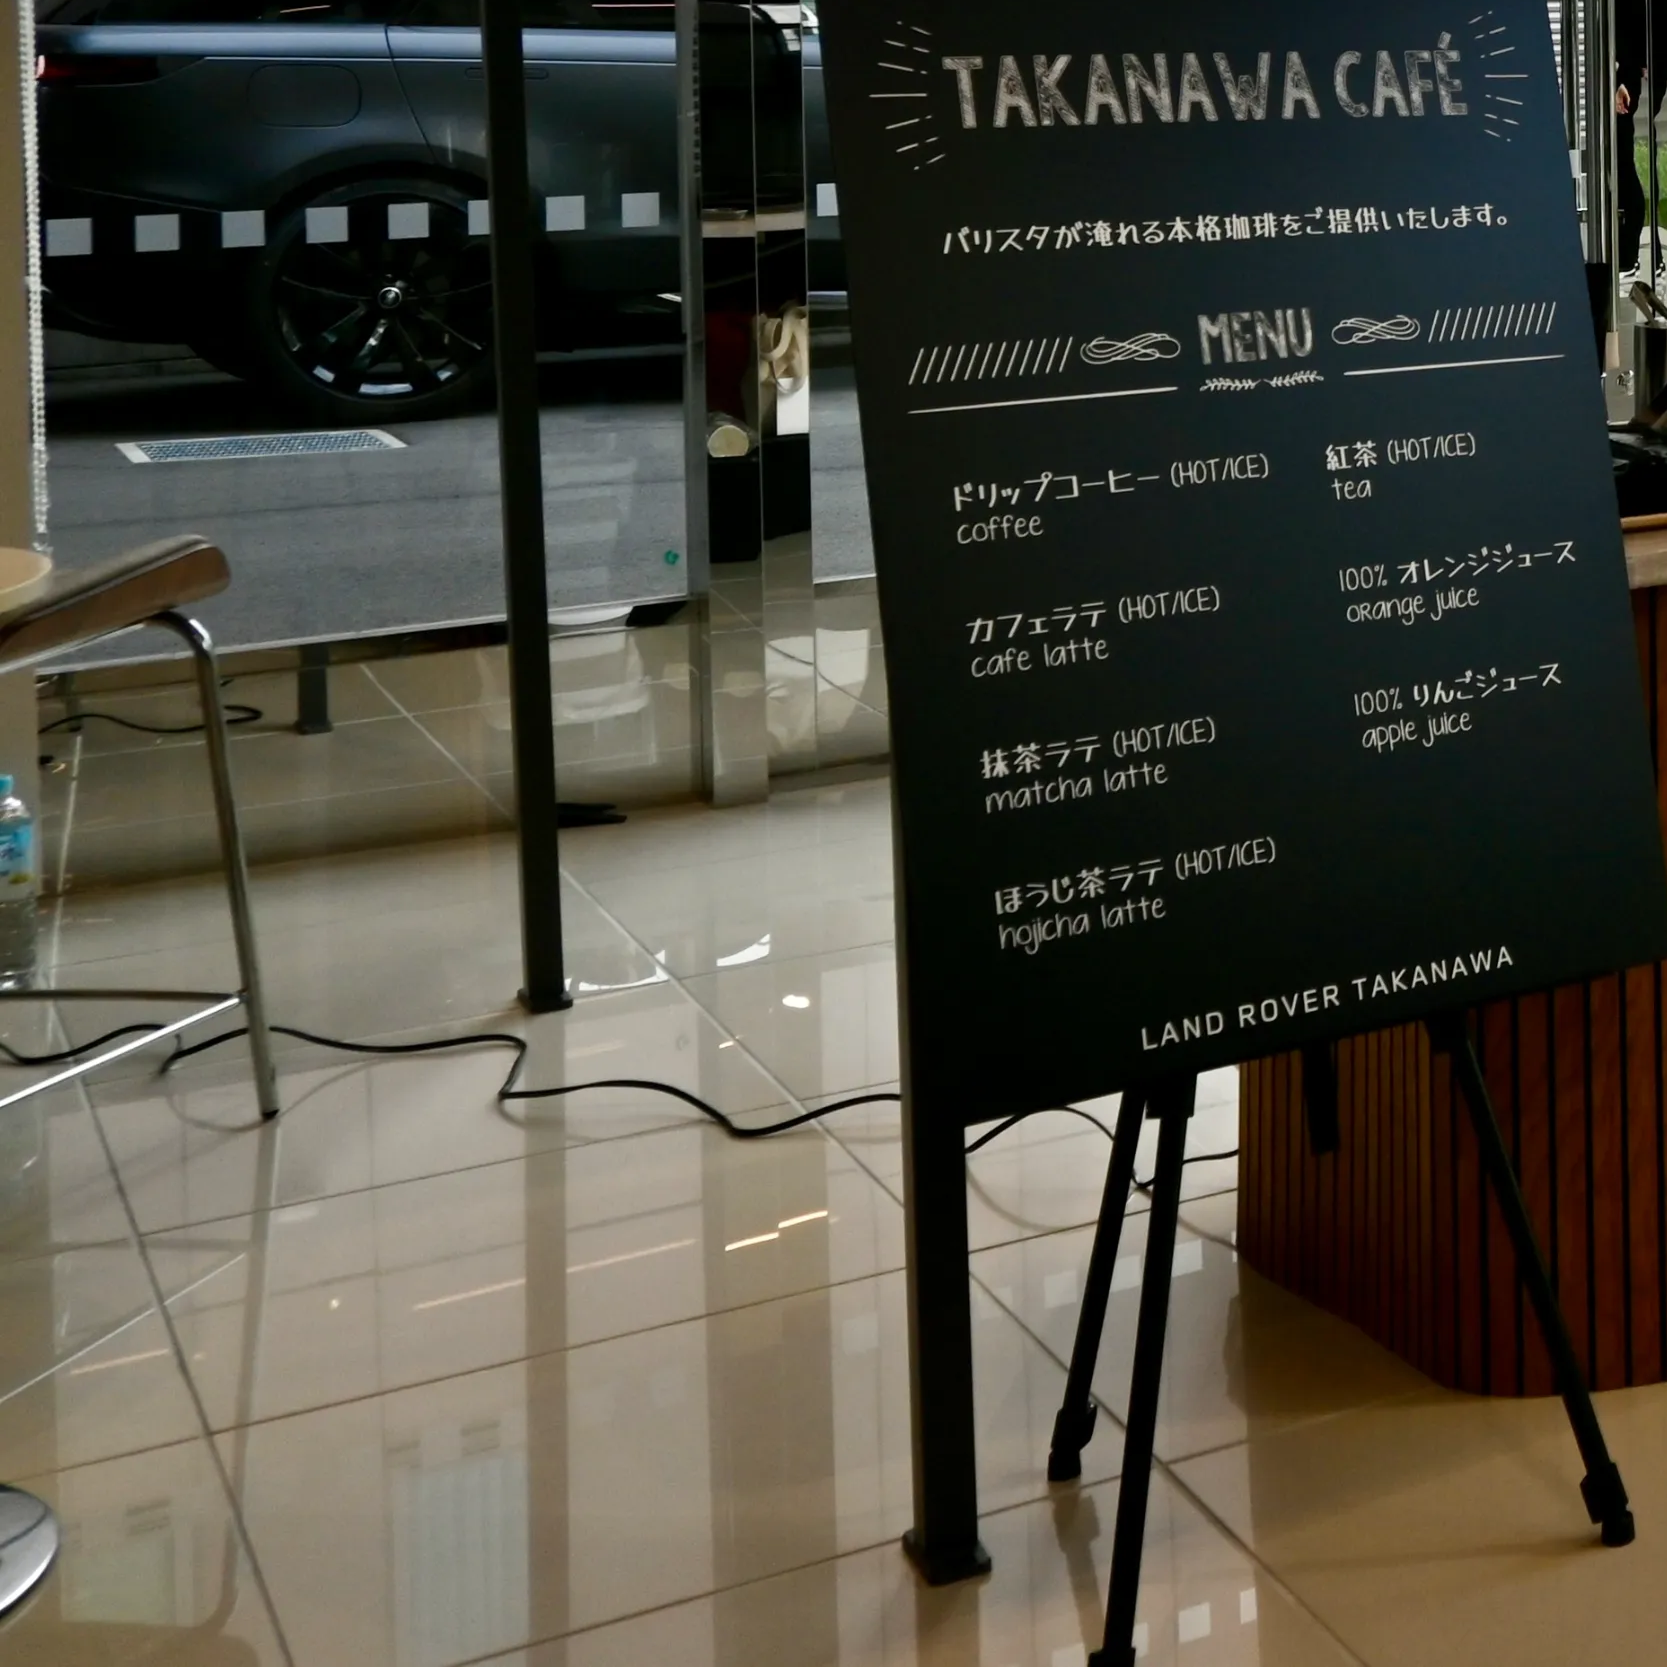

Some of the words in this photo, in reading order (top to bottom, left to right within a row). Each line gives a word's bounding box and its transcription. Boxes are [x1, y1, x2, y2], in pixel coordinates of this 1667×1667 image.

[943, 51, 1320, 128] TAKANAWA
[1334, 31, 1468, 117] CAFÉ
[1198, 307, 1313, 365] MENU
[1326, 440, 1377, 471] 紅茶
[1387, 432, 1475, 464] (HOT/ICE)
[954, 470, 1159, 511] ドリップコーヒー
[1171, 453, 1268, 487] (HOT/ICE)
[1332, 478, 1371, 500] tea
[958, 515, 1043, 544] coffee
[1339, 564, 1387, 591] 100%
[1397, 541, 1575, 583] オレンジジュース
[967, 602, 1106, 644] カフェラテ
[1119, 586, 1219, 623] (HOT/ICE)
[1431, 587, 1479, 621] juice
[972, 648, 1031, 677] cafe
[1044, 638, 1108, 666] latte
[1355, 688, 1402, 715] 100%
[1414, 663, 1561, 707] りんごジュース
[980, 736, 1100, 778] 抹茶ラテ
[1113, 717, 1215, 757] (HOT/ICE)
[1362, 719, 1417, 753] apple
[1423, 712, 1472, 747] juice
[986, 777, 1092, 813] matcha
[1104, 762, 1167, 792] latte
[995, 859, 1165, 915] ほうじ茶ラテ
[1176, 837, 1275, 880] (HOT/ICE)
[999, 914, 1088, 954] hojicha
[1101, 898, 1165, 928] latte
[1142, 1012, 1223, 1050] LAND
[1239, 985, 1339, 1027] ROVER
[1352, 946, 1512, 1000] TAKANAWA
